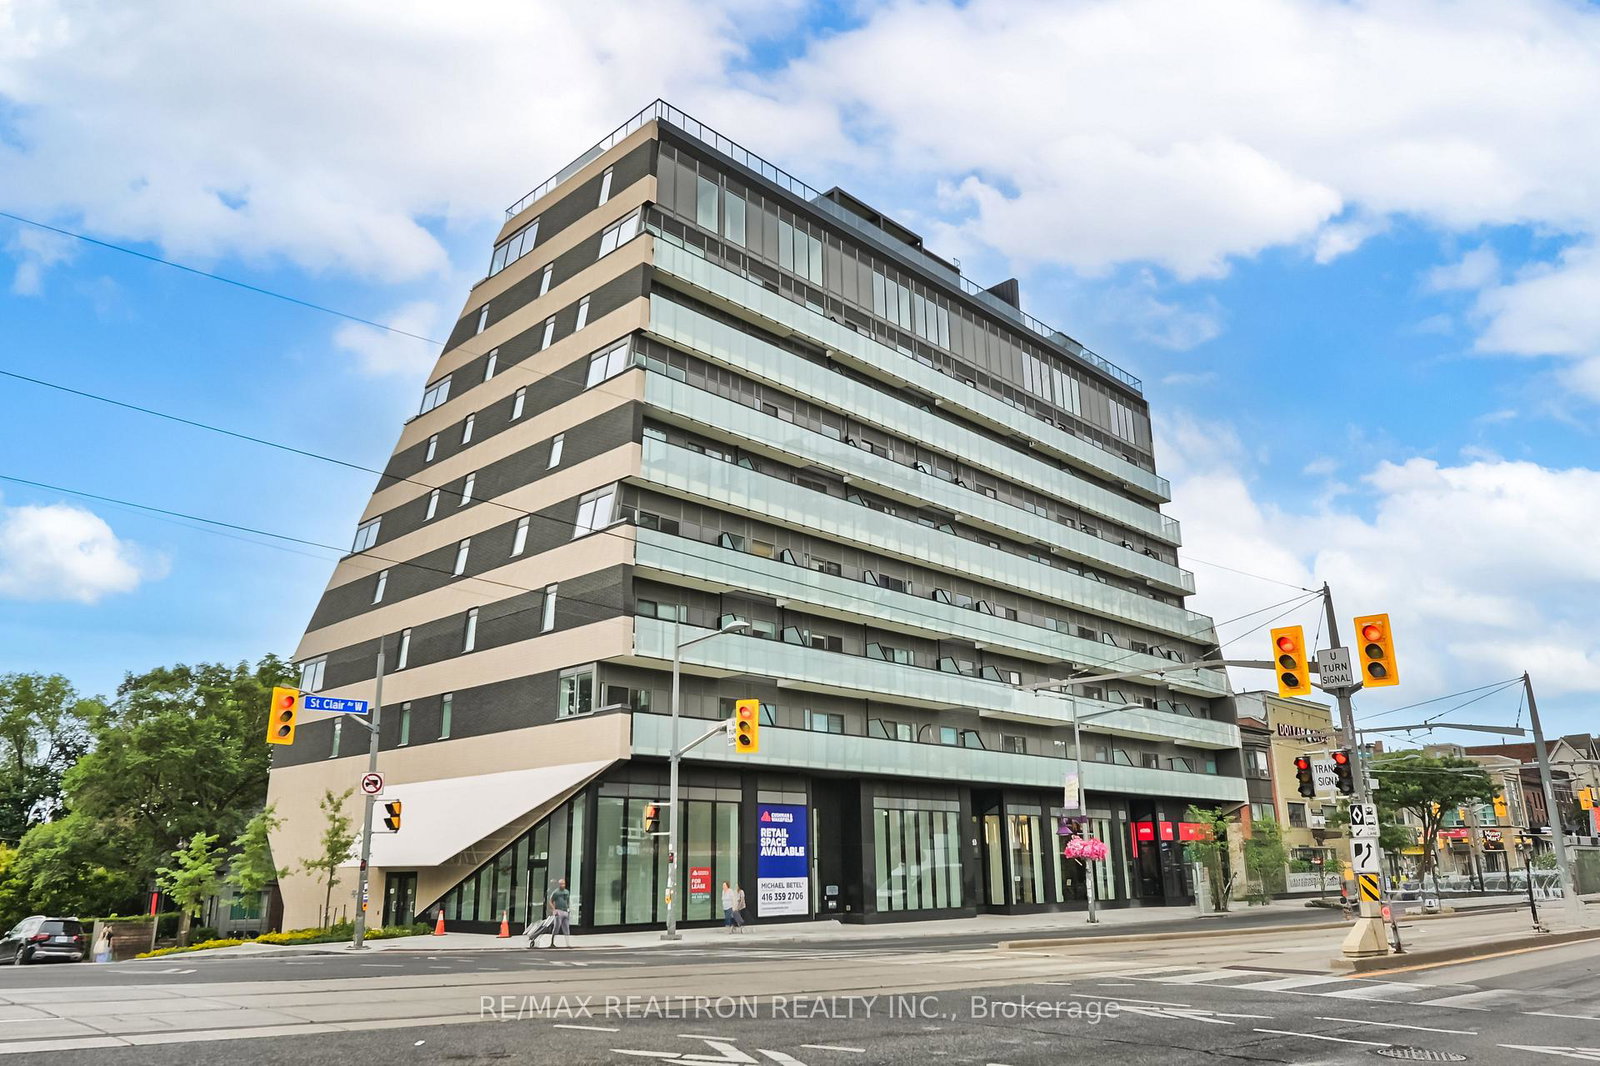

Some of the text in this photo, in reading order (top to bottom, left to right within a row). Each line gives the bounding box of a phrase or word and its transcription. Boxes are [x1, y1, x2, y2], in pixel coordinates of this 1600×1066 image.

[1330, 652, 1336, 660] U
[1323, 663, 1347, 672] TURN
[1323, 674, 1350, 684] SIGNAL
[310, 698, 320, 707] St
[323, 699, 345, 709] Clair
[355, 702, 363, 711] W
[761, 828, 789, 837] RETAIL
[761, 838, 787, 847] SPACE
[761, 846, 805, 856] AVAILABLE
[761, 892, 804, 901] 416 359 2706
